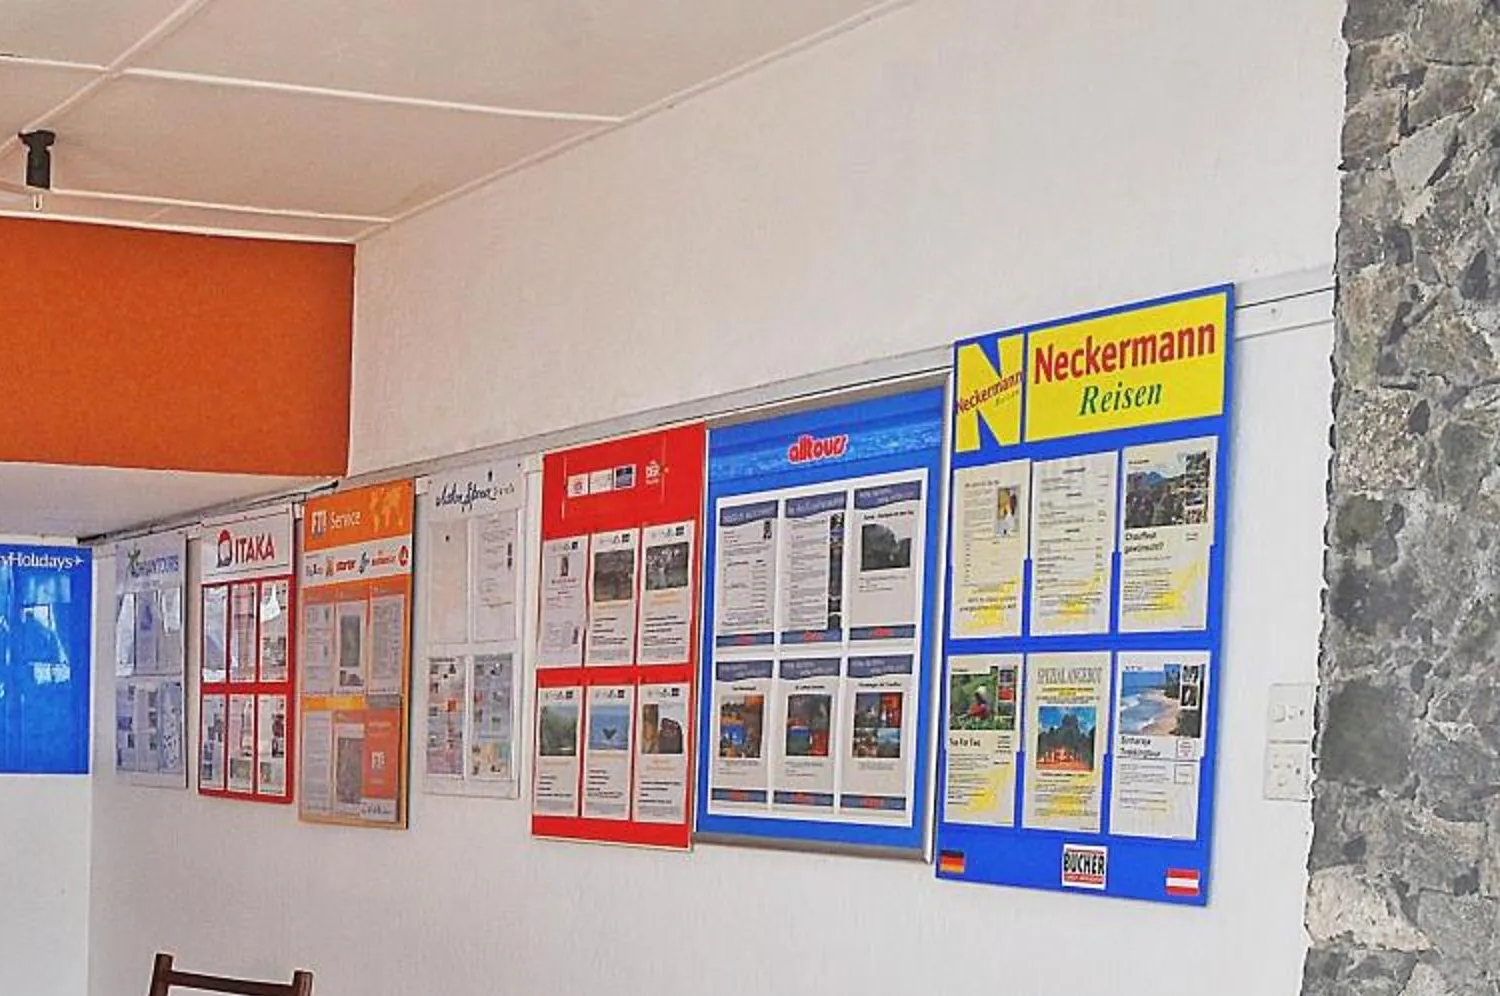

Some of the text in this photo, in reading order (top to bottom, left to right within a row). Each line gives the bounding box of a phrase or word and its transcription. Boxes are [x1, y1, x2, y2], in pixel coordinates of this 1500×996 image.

[1034, 323, 1215, 384] Neckermann
[956, 371, 1023, 414] Neckermann
[1079, 382, 1162, 416] Reisen
[789, 435, 847, 464] alltours
[331, 511, 360, 529] Service
[235, 533, 275, 564] ITAKA
[1064, 852, 1104, 875] BUCHER
